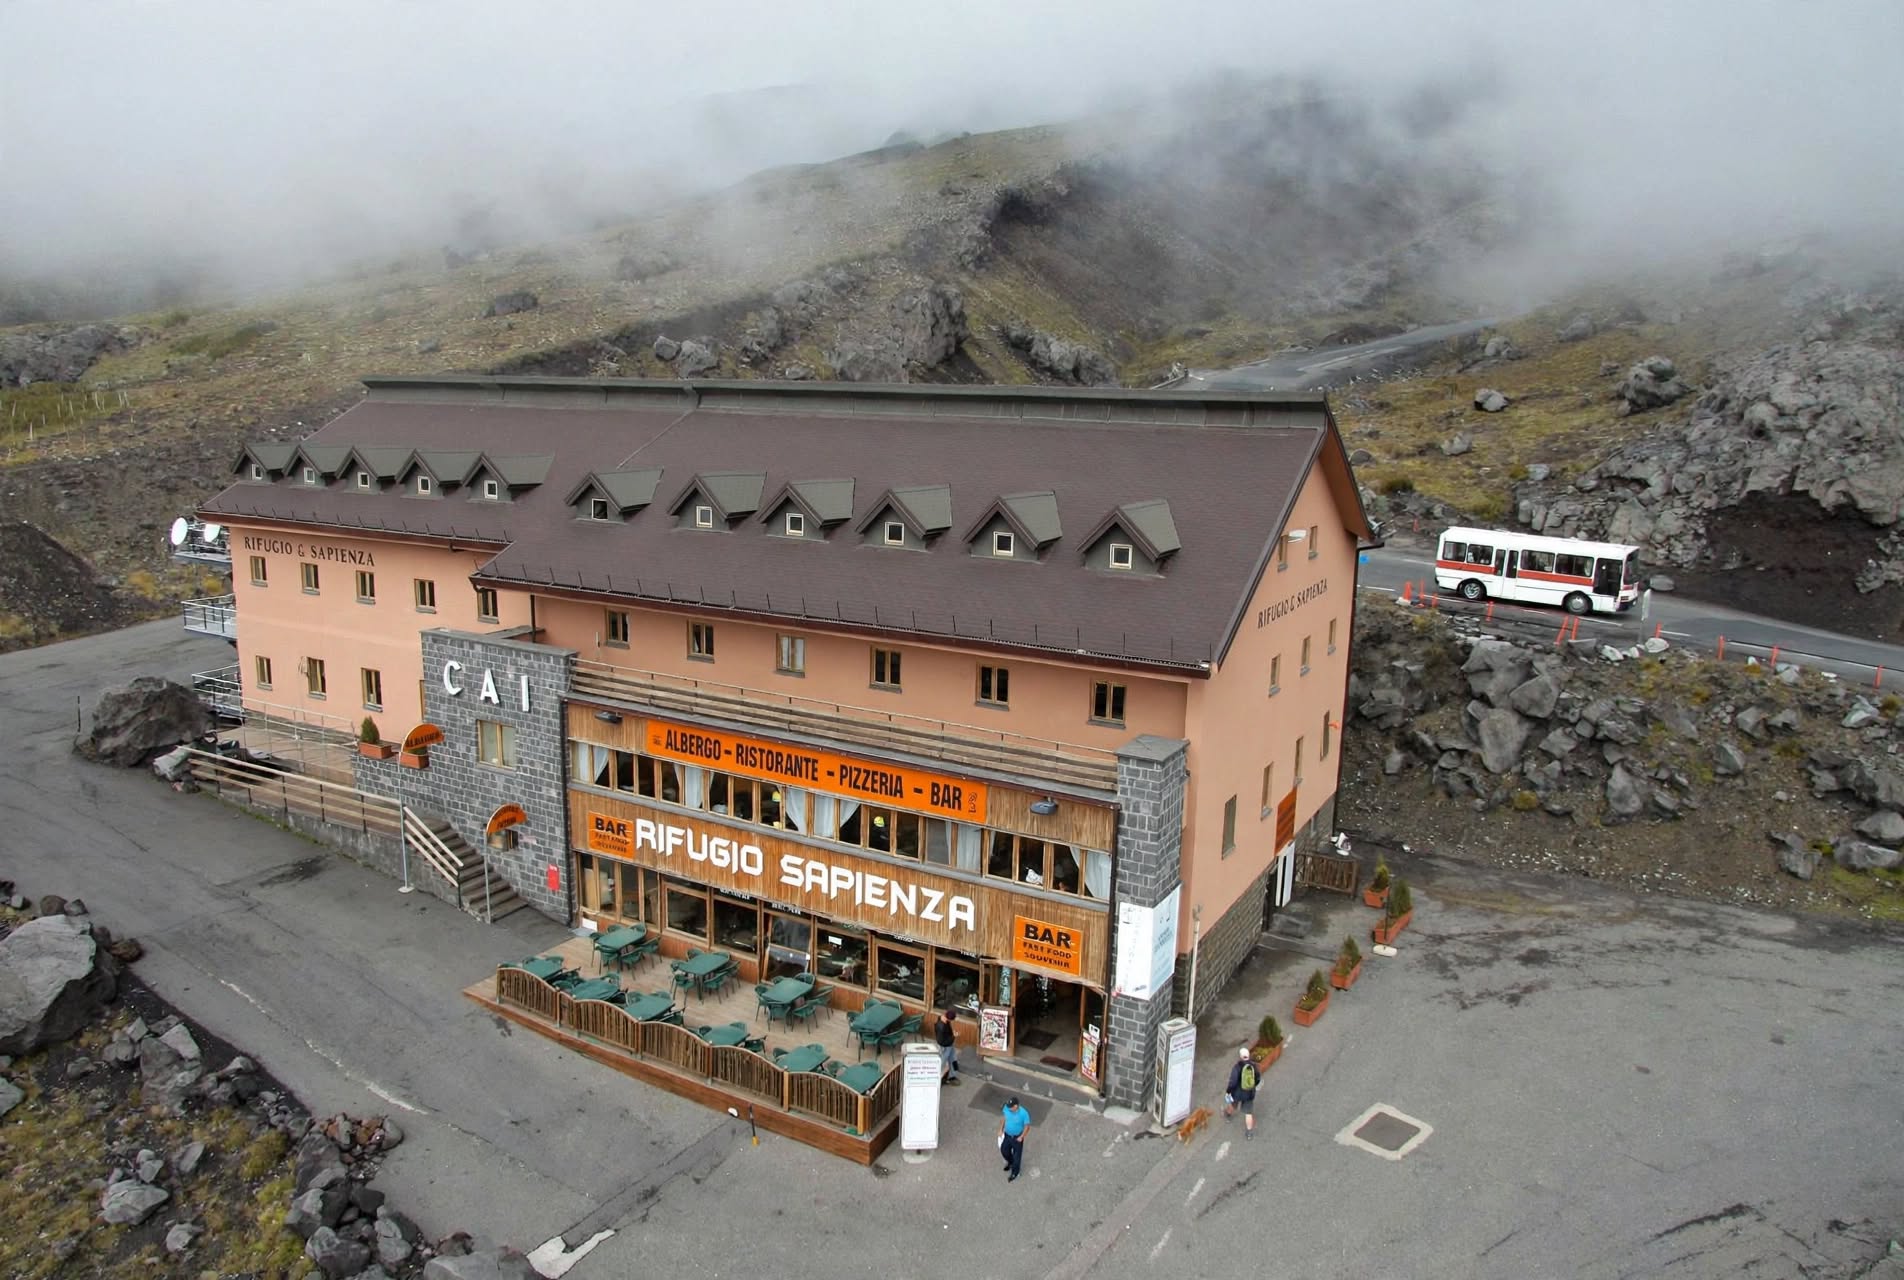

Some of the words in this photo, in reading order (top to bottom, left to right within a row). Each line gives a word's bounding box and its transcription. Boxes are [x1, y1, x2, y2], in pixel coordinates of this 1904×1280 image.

[244, 536, 292, 555] RIFUGIO
[311, 545, 375, 567] SAPIENZA
[1257, 599, 1289, 629] RIFUGIO
[1296, 578, 1328, 608] SAPIENZA
[665, 729, 721, 760] ALBERGO
[735, 743, 819, 782] RISTORANTE
[839, 764, 904, 799] PIZZERIA
[930, 781, 962, 811] BAR
[595, 817, 627, 838] BAR
[635, 818, 764, 876] RIFUGIO
[779, 853, 975, 931] SAPIENZA
[1023, 942, 1044, 952] FAST
[1047, 948, 1072, 959] FOOD
[1024, 924, 1071, 949] BAR
[1024, 952, 1070, 968] SOUVENIR
